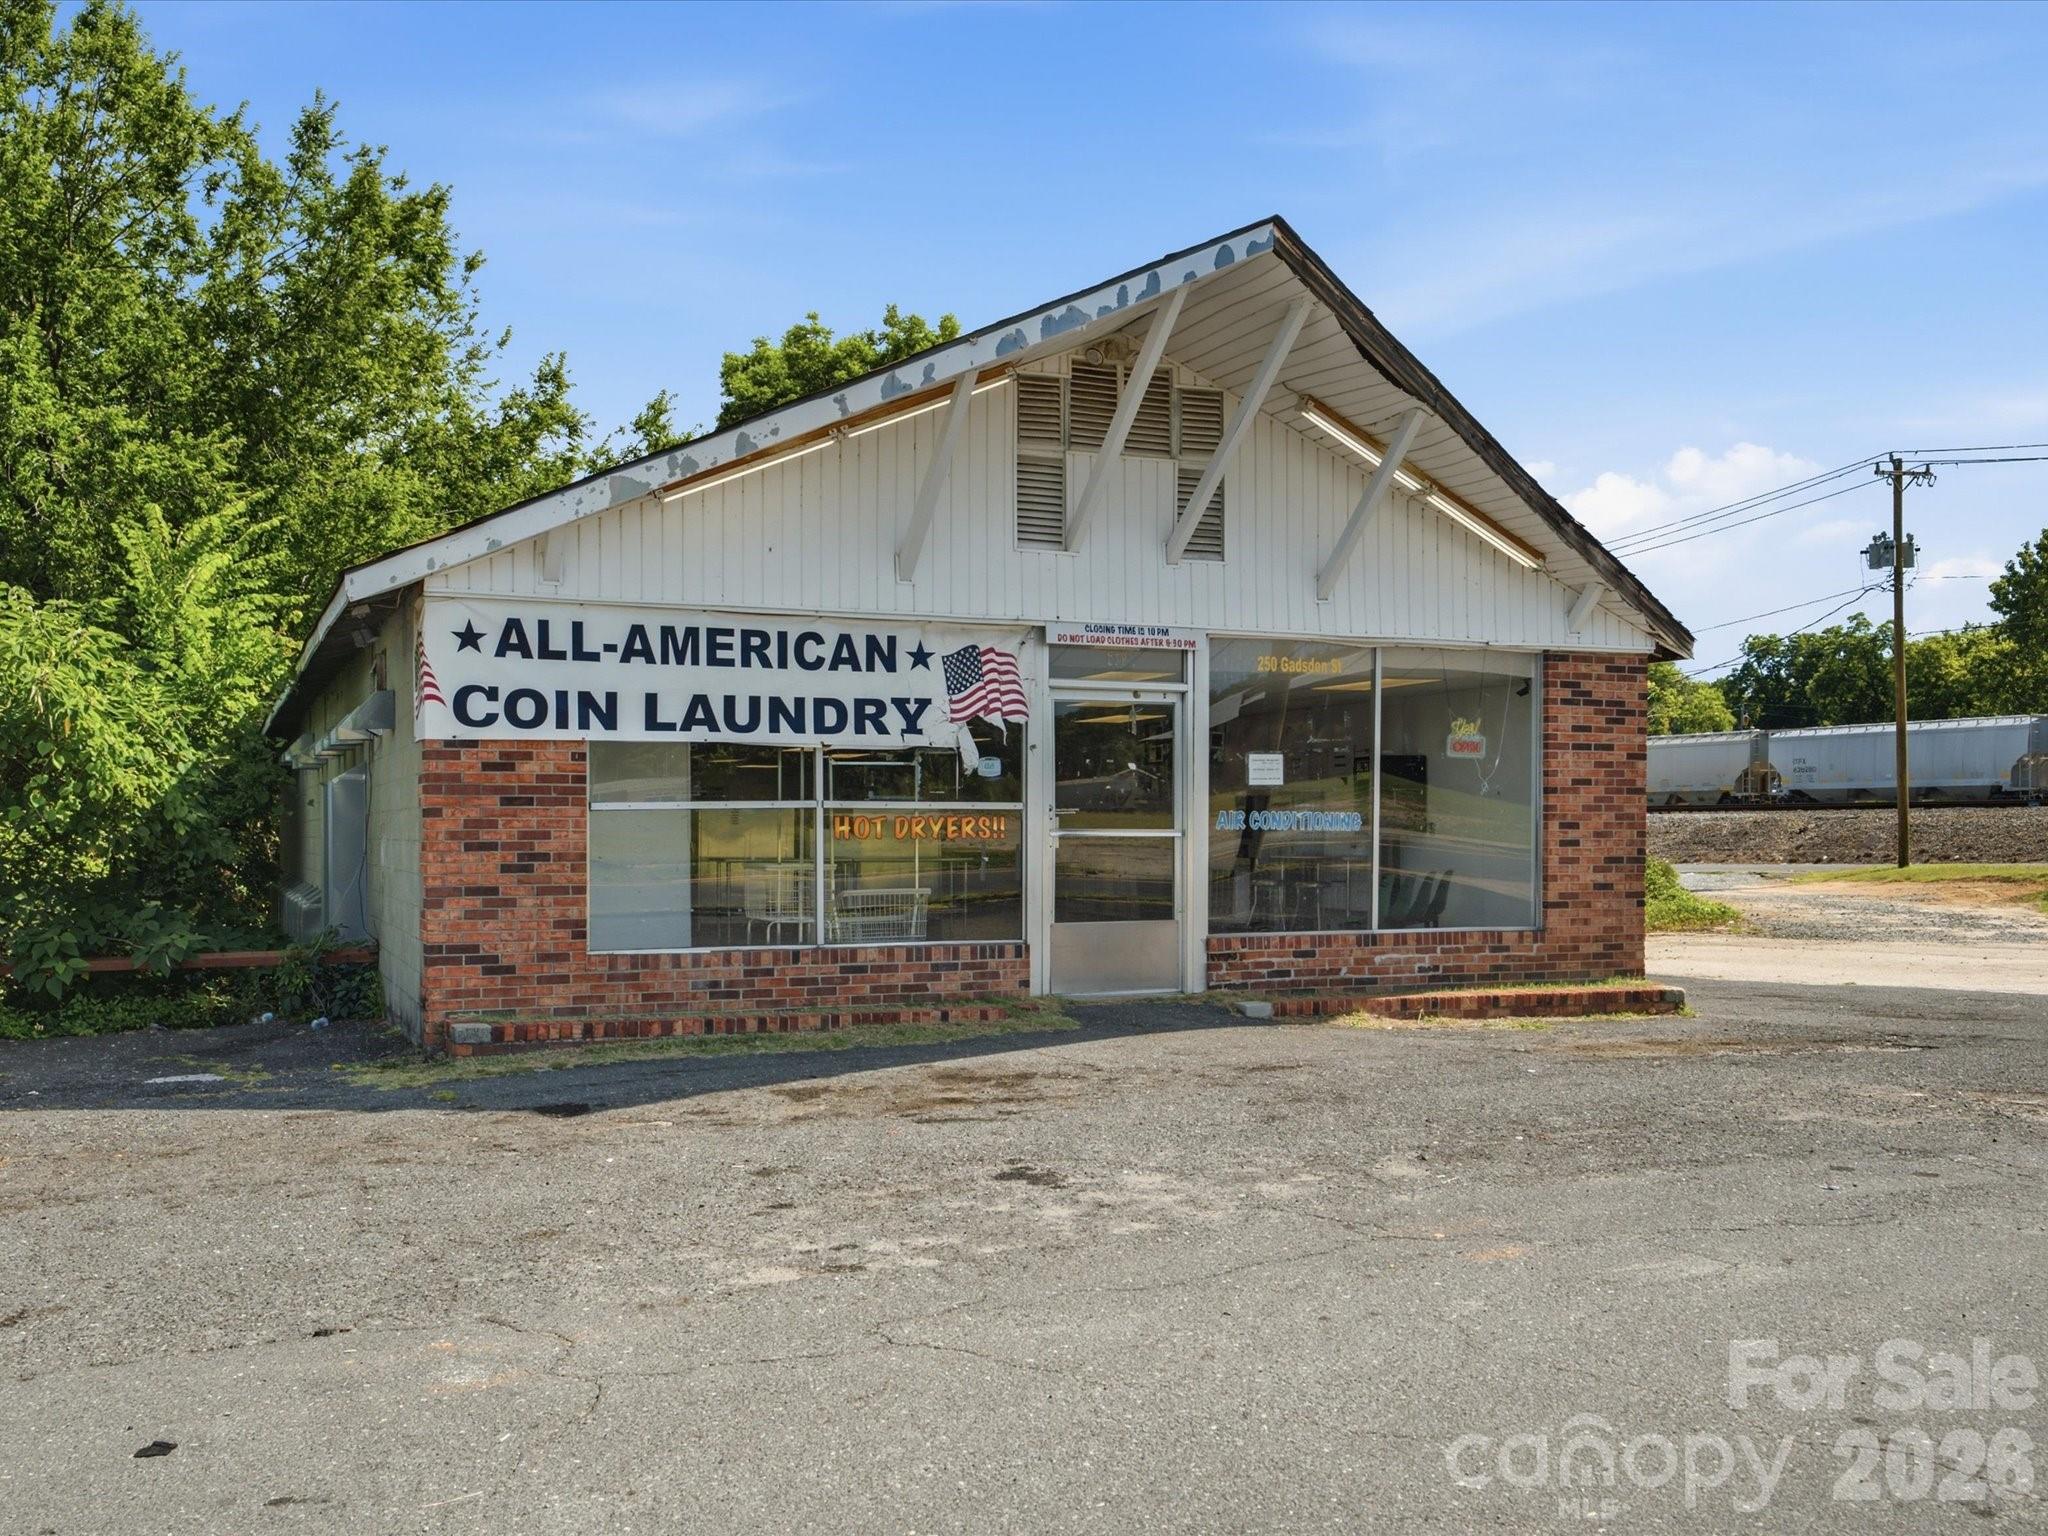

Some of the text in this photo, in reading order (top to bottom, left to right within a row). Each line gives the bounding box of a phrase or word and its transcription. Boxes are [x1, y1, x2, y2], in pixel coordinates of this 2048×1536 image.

[1085, 624, 1115, 634] CLOSING
[1118, 626, 1136, 635] TIME
[1148, 628, 1155, 636] 10
[1157, 628, 1170, 637] PM
[494, 617, 897, 673] ALL-AMERICAN
[1058, 634, 1067, 642] DO
[1070, 635, 1084, 643] NOT
[1087, 636, 1105, 644] LOAD
[1107, 637, 1138, 645] CLOTHES
[1141, 638, 1164, 646] AFTER
[1184, 640, 1197, 648] PM
[1257, 657, 1278, 672] 250
[453, 685, 932, 735] COIN LAUNDRY
[833, 815, 1006, 840] HOT DRYERS!!
[1216, 811, 1362, 831] AIR CONDITIONING
